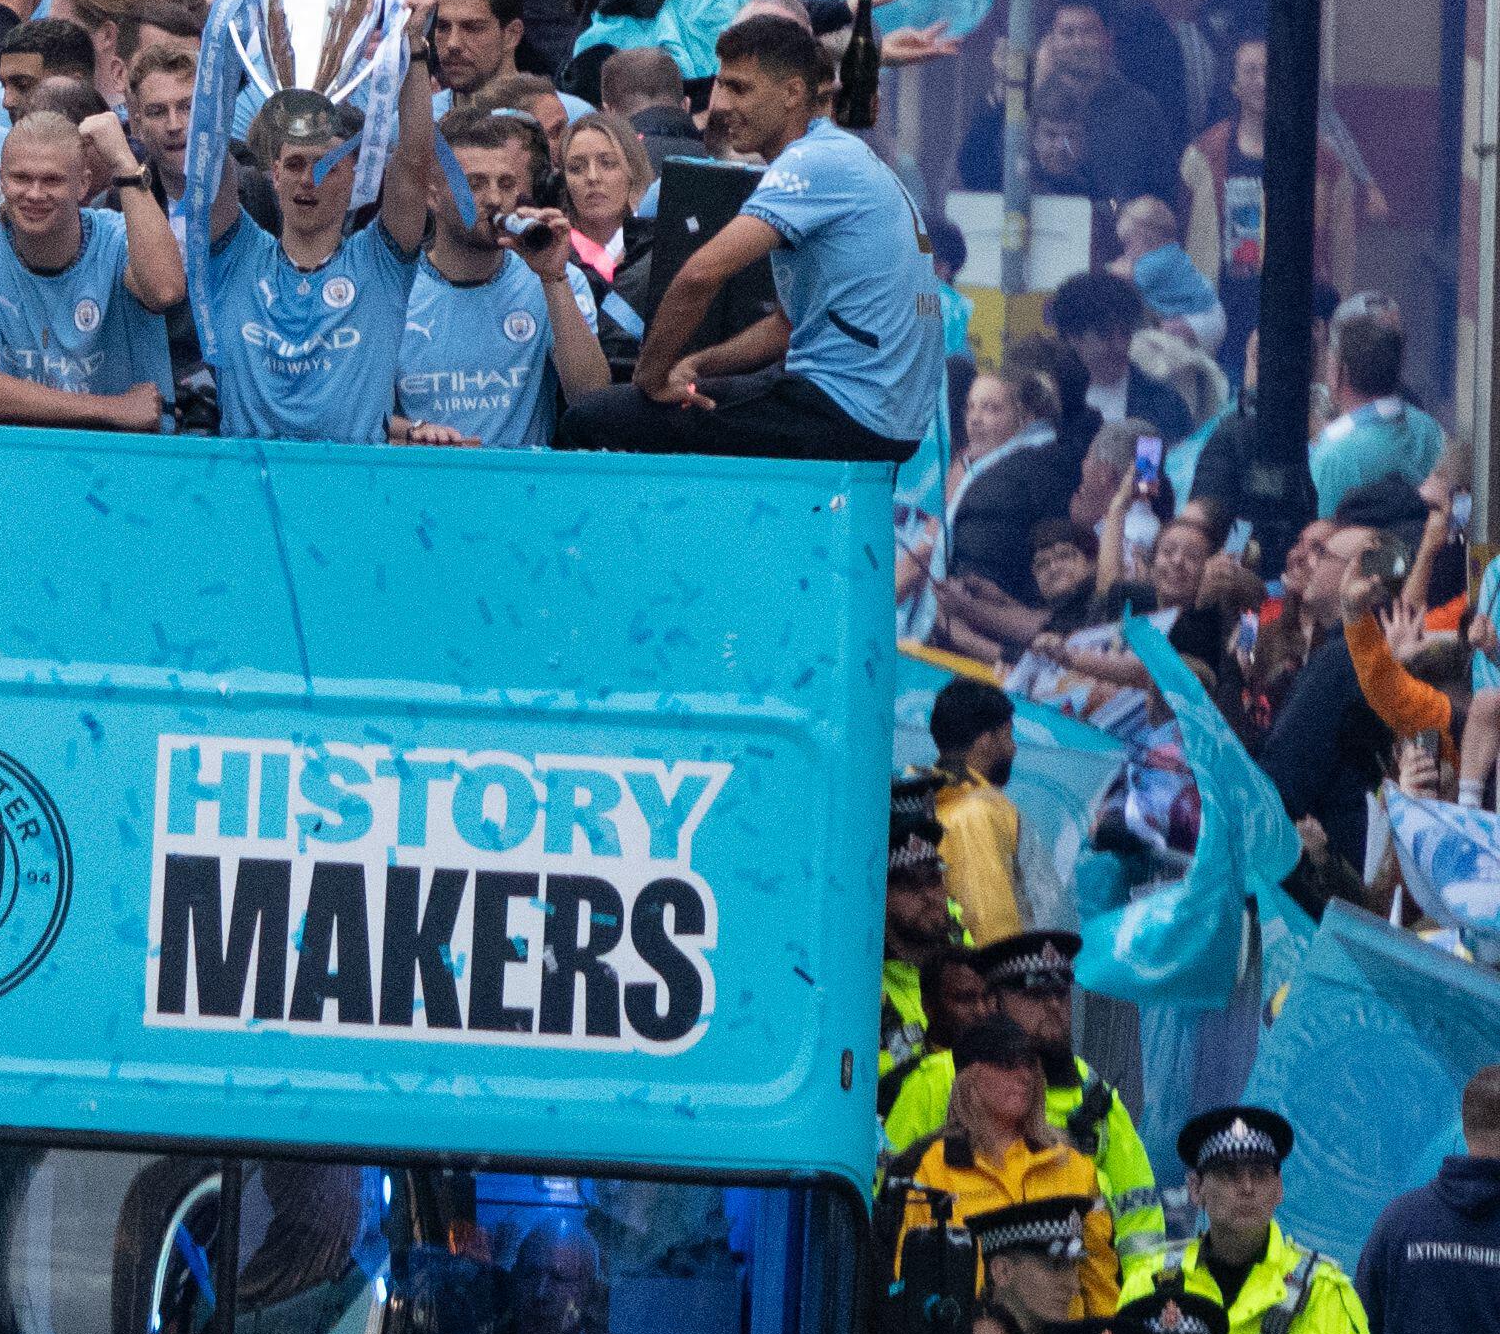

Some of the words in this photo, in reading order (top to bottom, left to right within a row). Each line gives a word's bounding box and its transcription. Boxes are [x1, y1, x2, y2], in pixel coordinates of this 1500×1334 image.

[242, 322, 362, 358] ETIHAD
[432, 394, 511, 412] AIRWAYS
[164, 745, 714, 864] HISTORY
[26, 869, 52, 888] 94
[156, 853, 706, 1043] MAKERS
